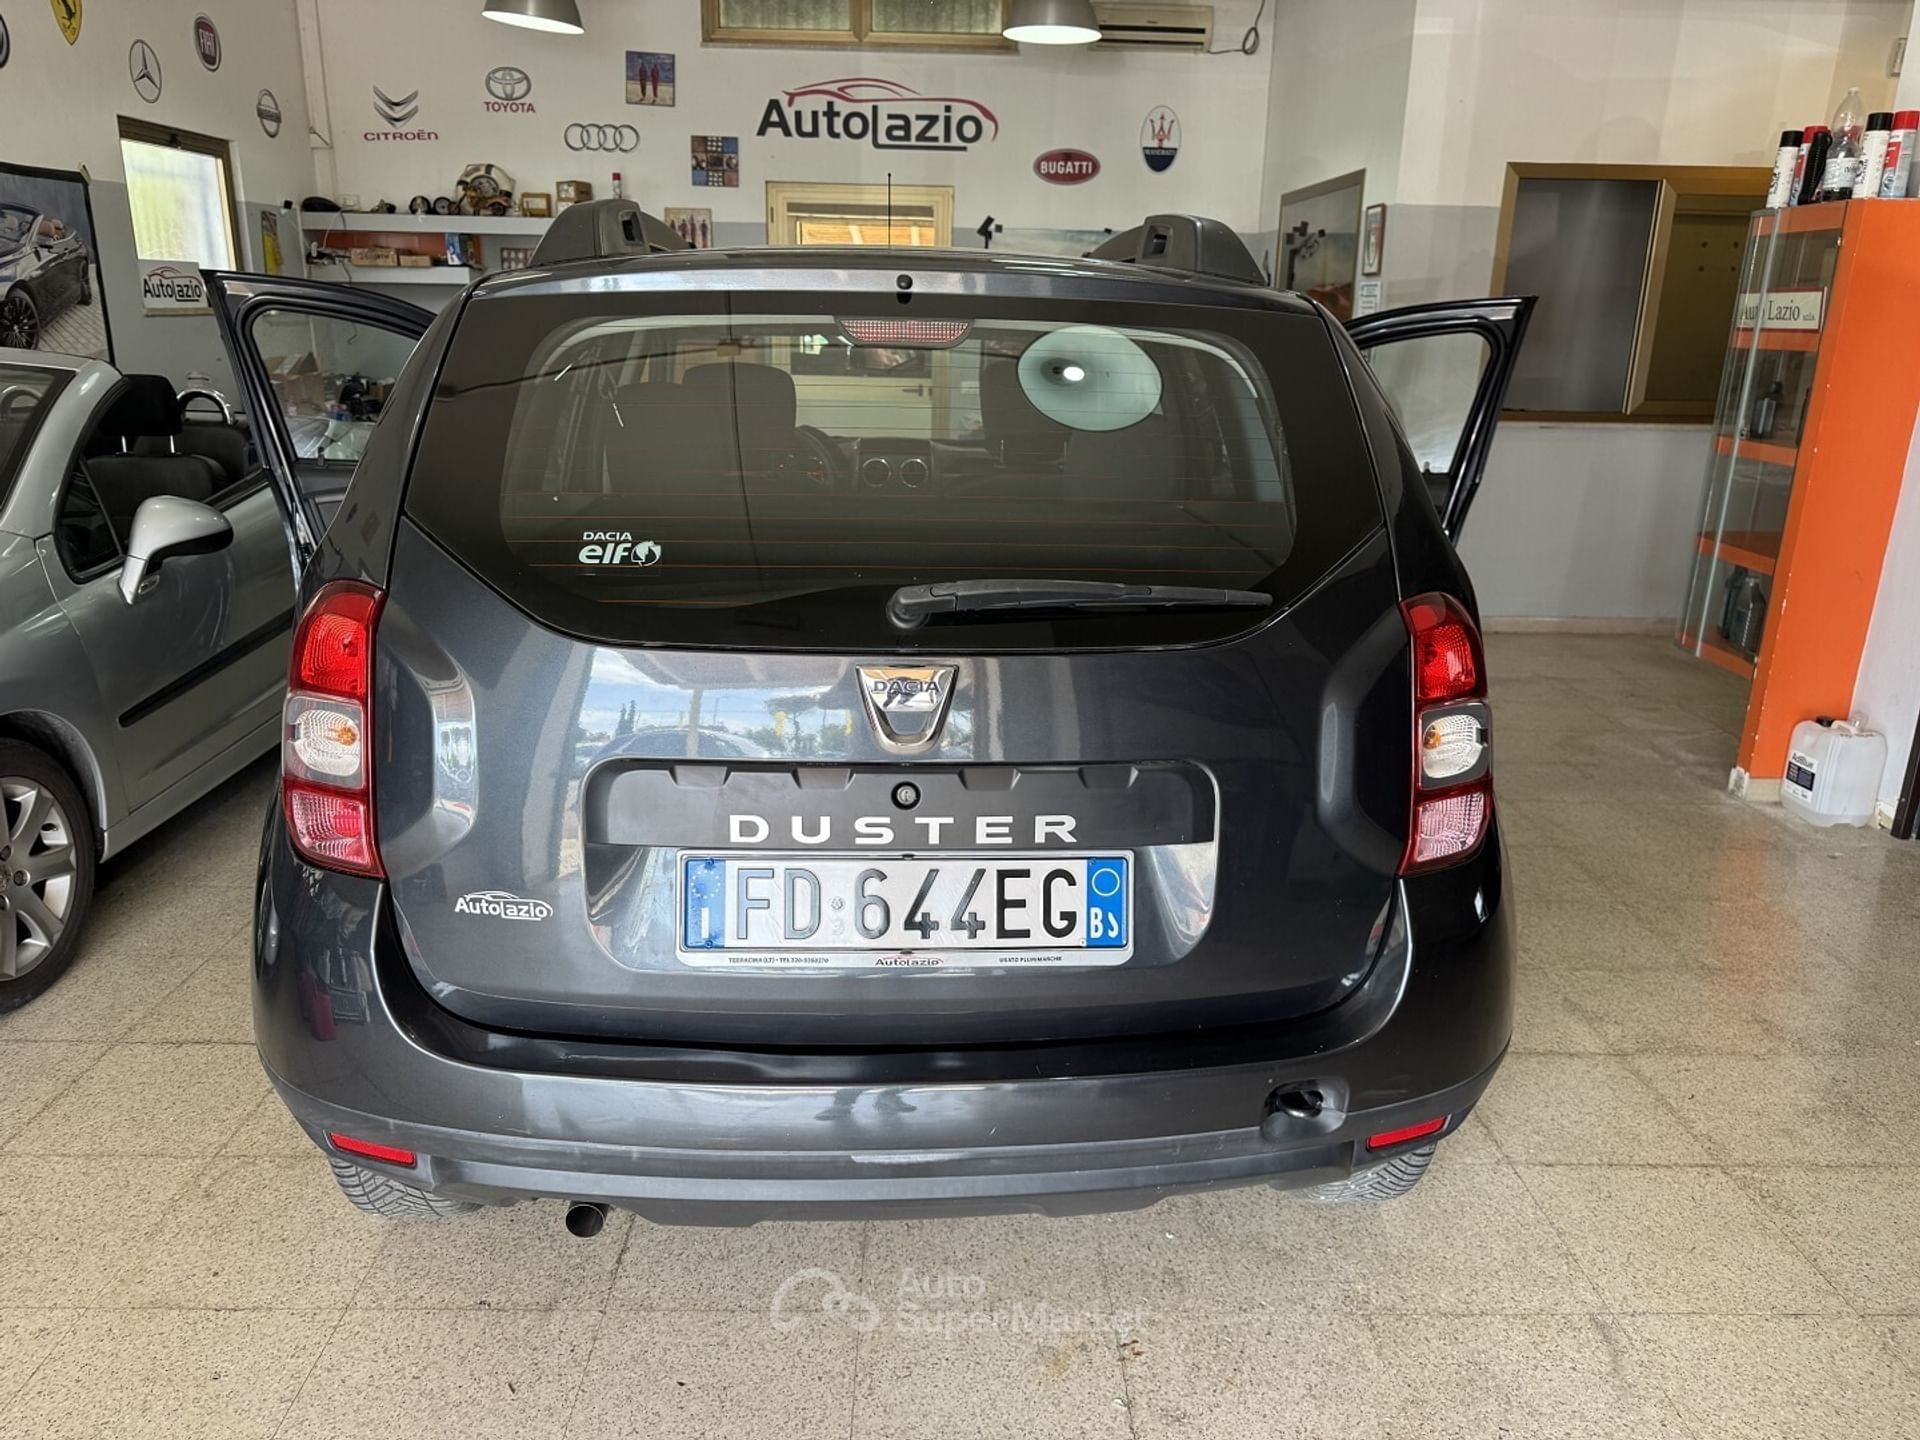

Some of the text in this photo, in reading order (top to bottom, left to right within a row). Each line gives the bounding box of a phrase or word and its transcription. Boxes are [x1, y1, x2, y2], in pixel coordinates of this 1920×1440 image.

[483, 101, 536, 113] TOYOTA
[1040, 161, 1093, 174] BUGATTI
[1767, 299, 1801, 321] Lazio
[582, 532, 633, 541] DACIA
[578, 543, 632, 564] elf
[872, 681, 940, 692] DACIA
[729, 814, 1078, 845] DUSTER
